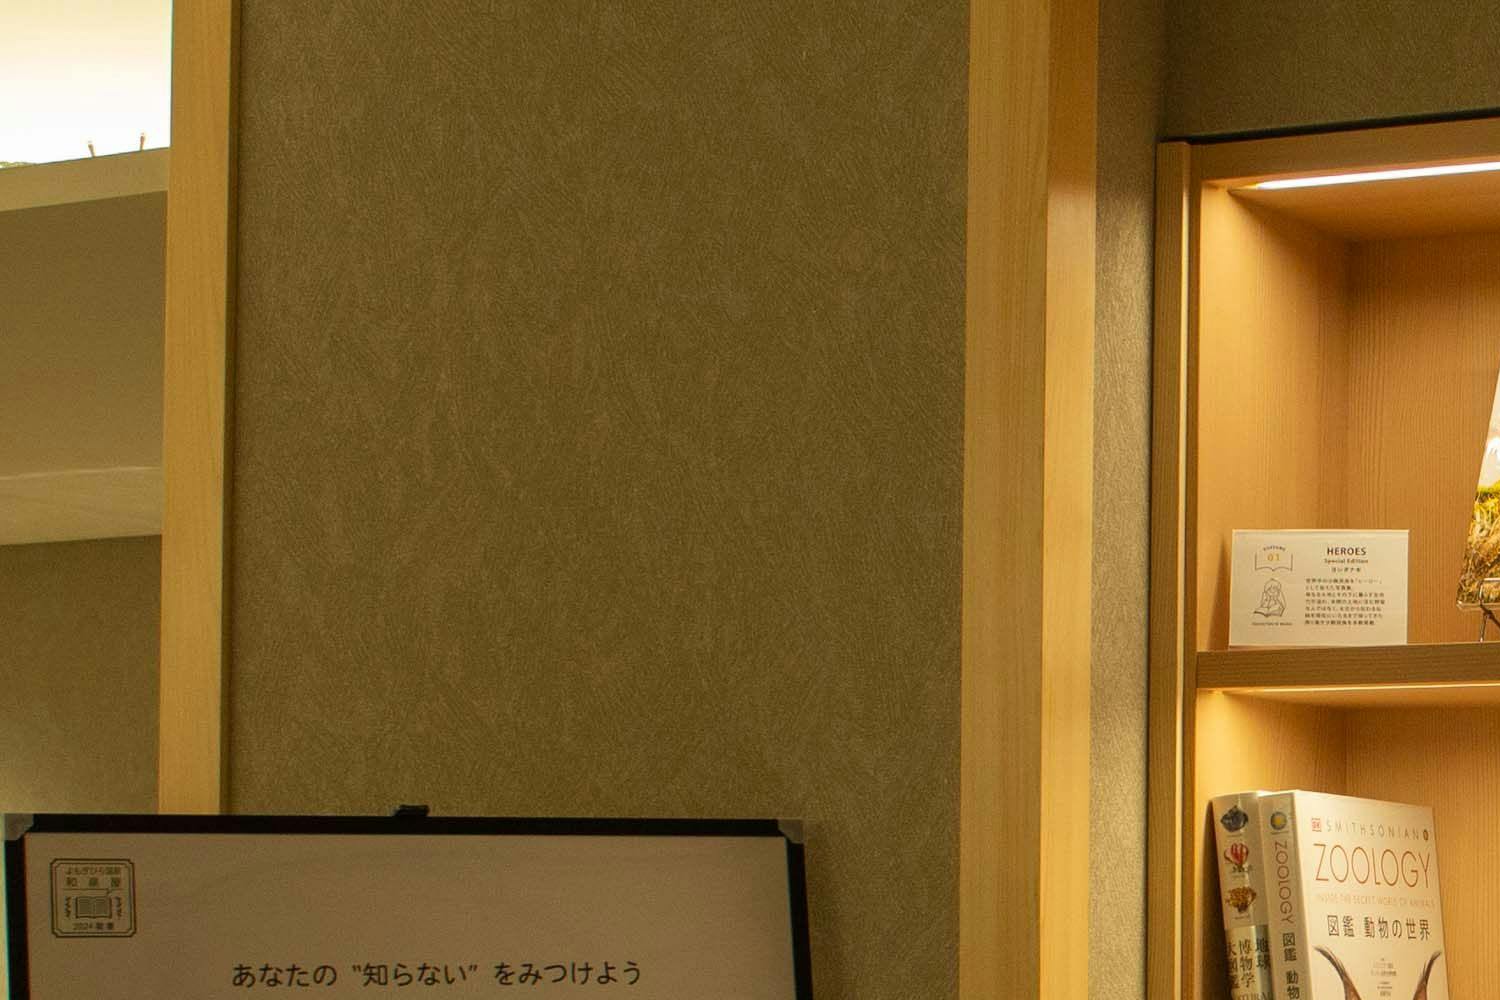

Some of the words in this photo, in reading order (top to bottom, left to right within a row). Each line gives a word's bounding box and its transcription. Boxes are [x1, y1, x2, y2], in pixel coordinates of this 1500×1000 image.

[1327, 547, 1367, 556] HEROES
[1326, 822, 1419, 841] SMITHSONIAN
[1313, 843, 1431, 888] ZOOLOGY
[1274, 841, 1294, 923] ZOOLOGY
[1327, 915, 1354, 938] 図鑑
[1364, 916, 1431, 940] 動物の世界
